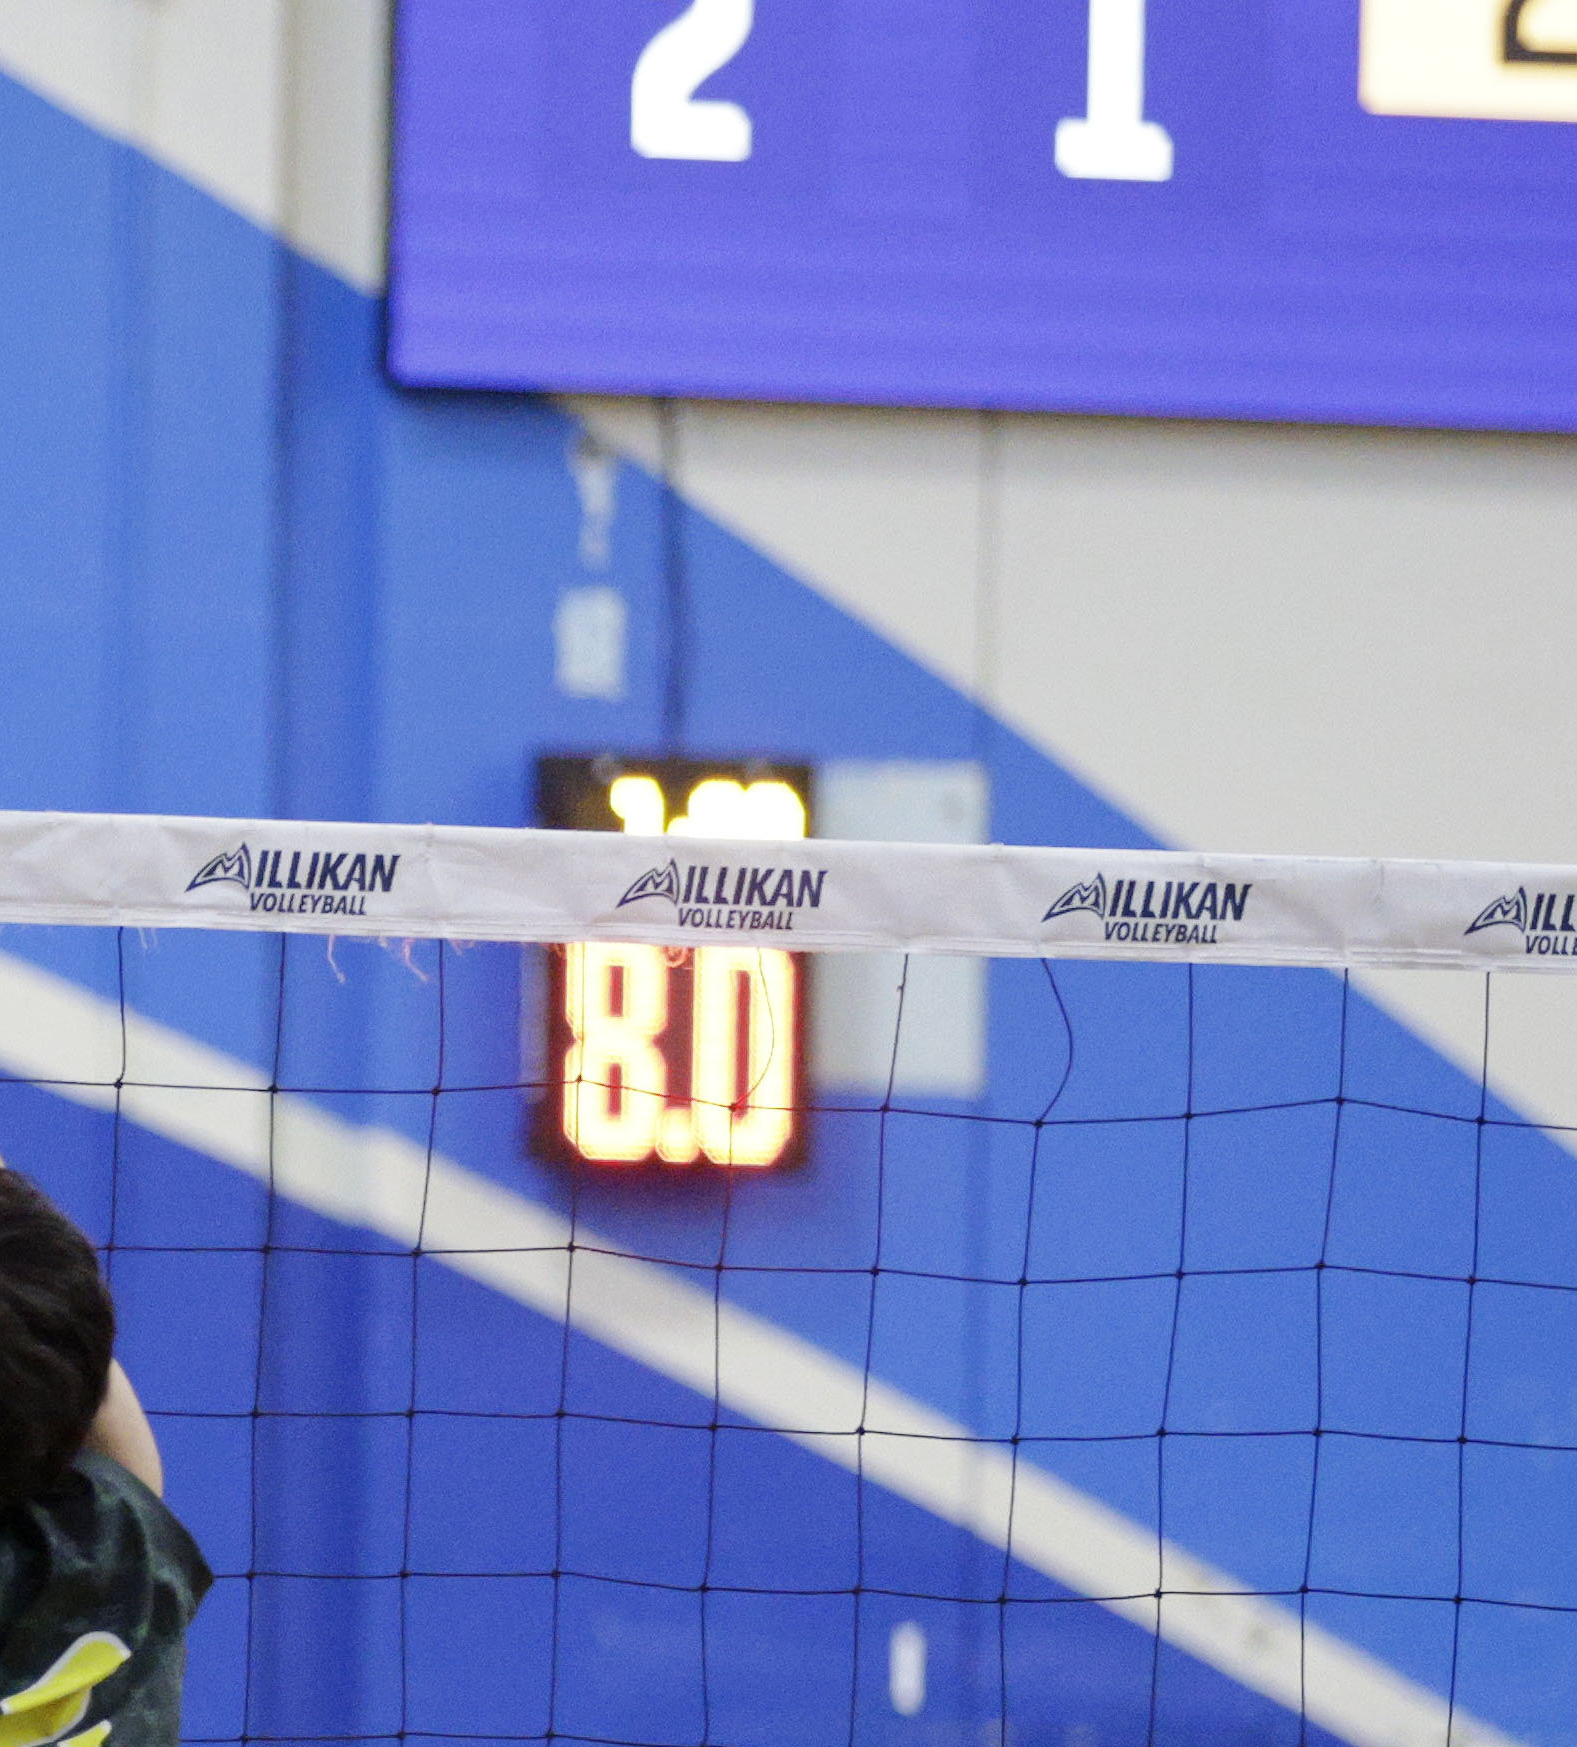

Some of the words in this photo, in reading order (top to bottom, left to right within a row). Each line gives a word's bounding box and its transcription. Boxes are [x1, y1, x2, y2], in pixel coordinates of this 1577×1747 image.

[250, 892, 368, 916] VOLLEYBALL
[679, 908, 795, 931] VOLLEYBALL
[1105, 922, 1219, 945] VOLLEYBALL
